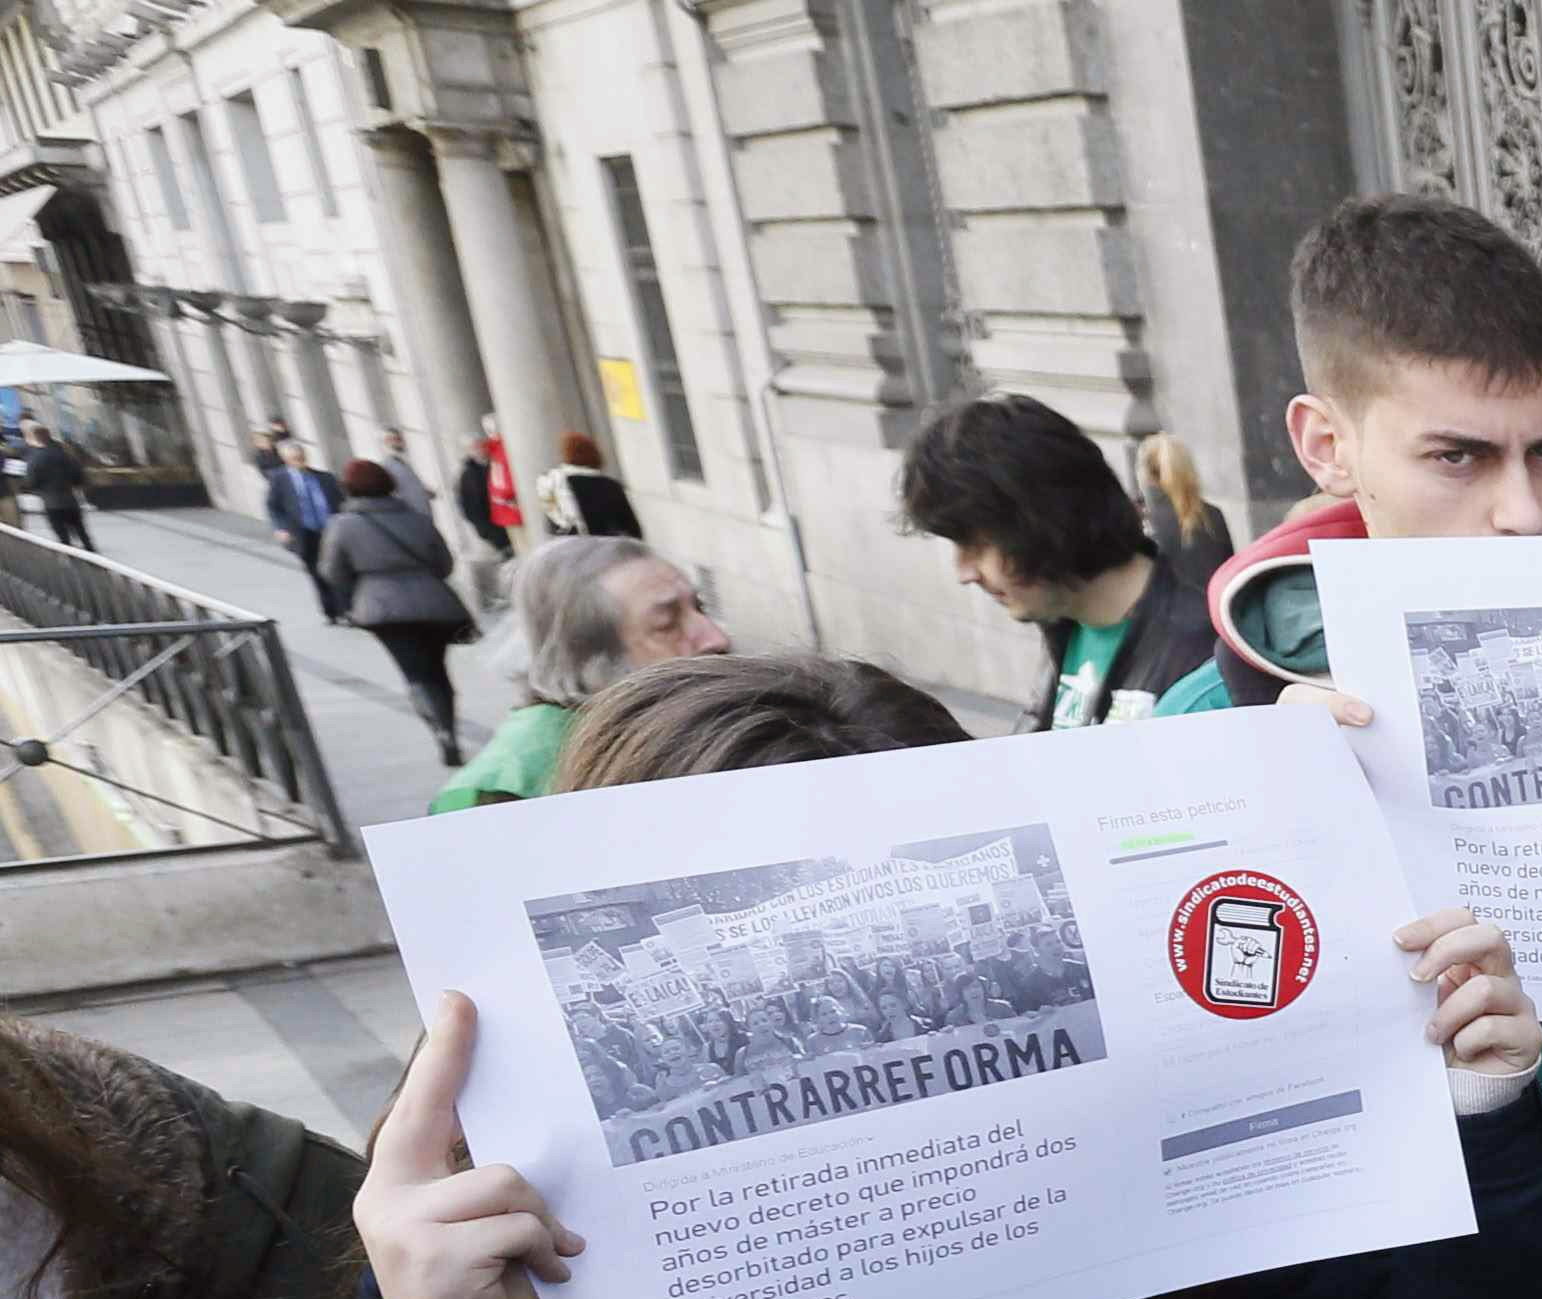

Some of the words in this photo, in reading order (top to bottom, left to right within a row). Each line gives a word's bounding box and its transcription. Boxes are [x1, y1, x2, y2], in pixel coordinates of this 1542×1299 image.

[1097, 814, 1144, 831] Firma
[1150, 808, 1183, 824] esta
[1188, 796, 1246, 818] petición
[1454, 837, 1486, 855] Por
[1492, 841, 1508, 857] la
[1457, 861, 1512, 877] nuevo
[1459, 881, 1502, 897] años
[1508, 882, 1529, 900] de
[1172, 874, 1316, 984] www.sindicatodeestudiantes.net
[1154, 990, 1184, 1004] Espa
[628, 1028, 1082, 1163] CONTRARREFORMA
[649, 1198, 698, 1221] Por
[709, 1187, 734, 1209] la
[743, 1163, 849, 1201] retirada
[856, 1134, 981, 1176] inmediata
[987, 1119, 1024, 1145] del
[656, 1214, 741, 1247] nuevo
[749, 1188, 849, 1227] decreto
[858, 1177, 905, 1203] que
[912, 1145, 1029, 1188] impondrá
[1036, 1133, 1077, 1160] dos
[662, 1242, 729, 1272] años
[736, 1231, 769, 1255] de
[777, 1208, 870, 1246] máster
[879, 1206, 894, 1221] a
[900, 1185, 976, 1220] precio
[668, 1244, 828, 1299] desorbitado
[837, 1232, 895, 1261] para
[902, 1203, 1006, 1245] expulsar
[1014, 1192, 1040, 1217] de
[1047, 1185, 1067, 1205] la
[839, 1266, 854, 1281] a
[862, 1253, 899, 1277] los
[905, 1238, 964, 1269] hijos
[971, 1227, 999, 1251] de
[1006, 1218, 1040, 1242] los
